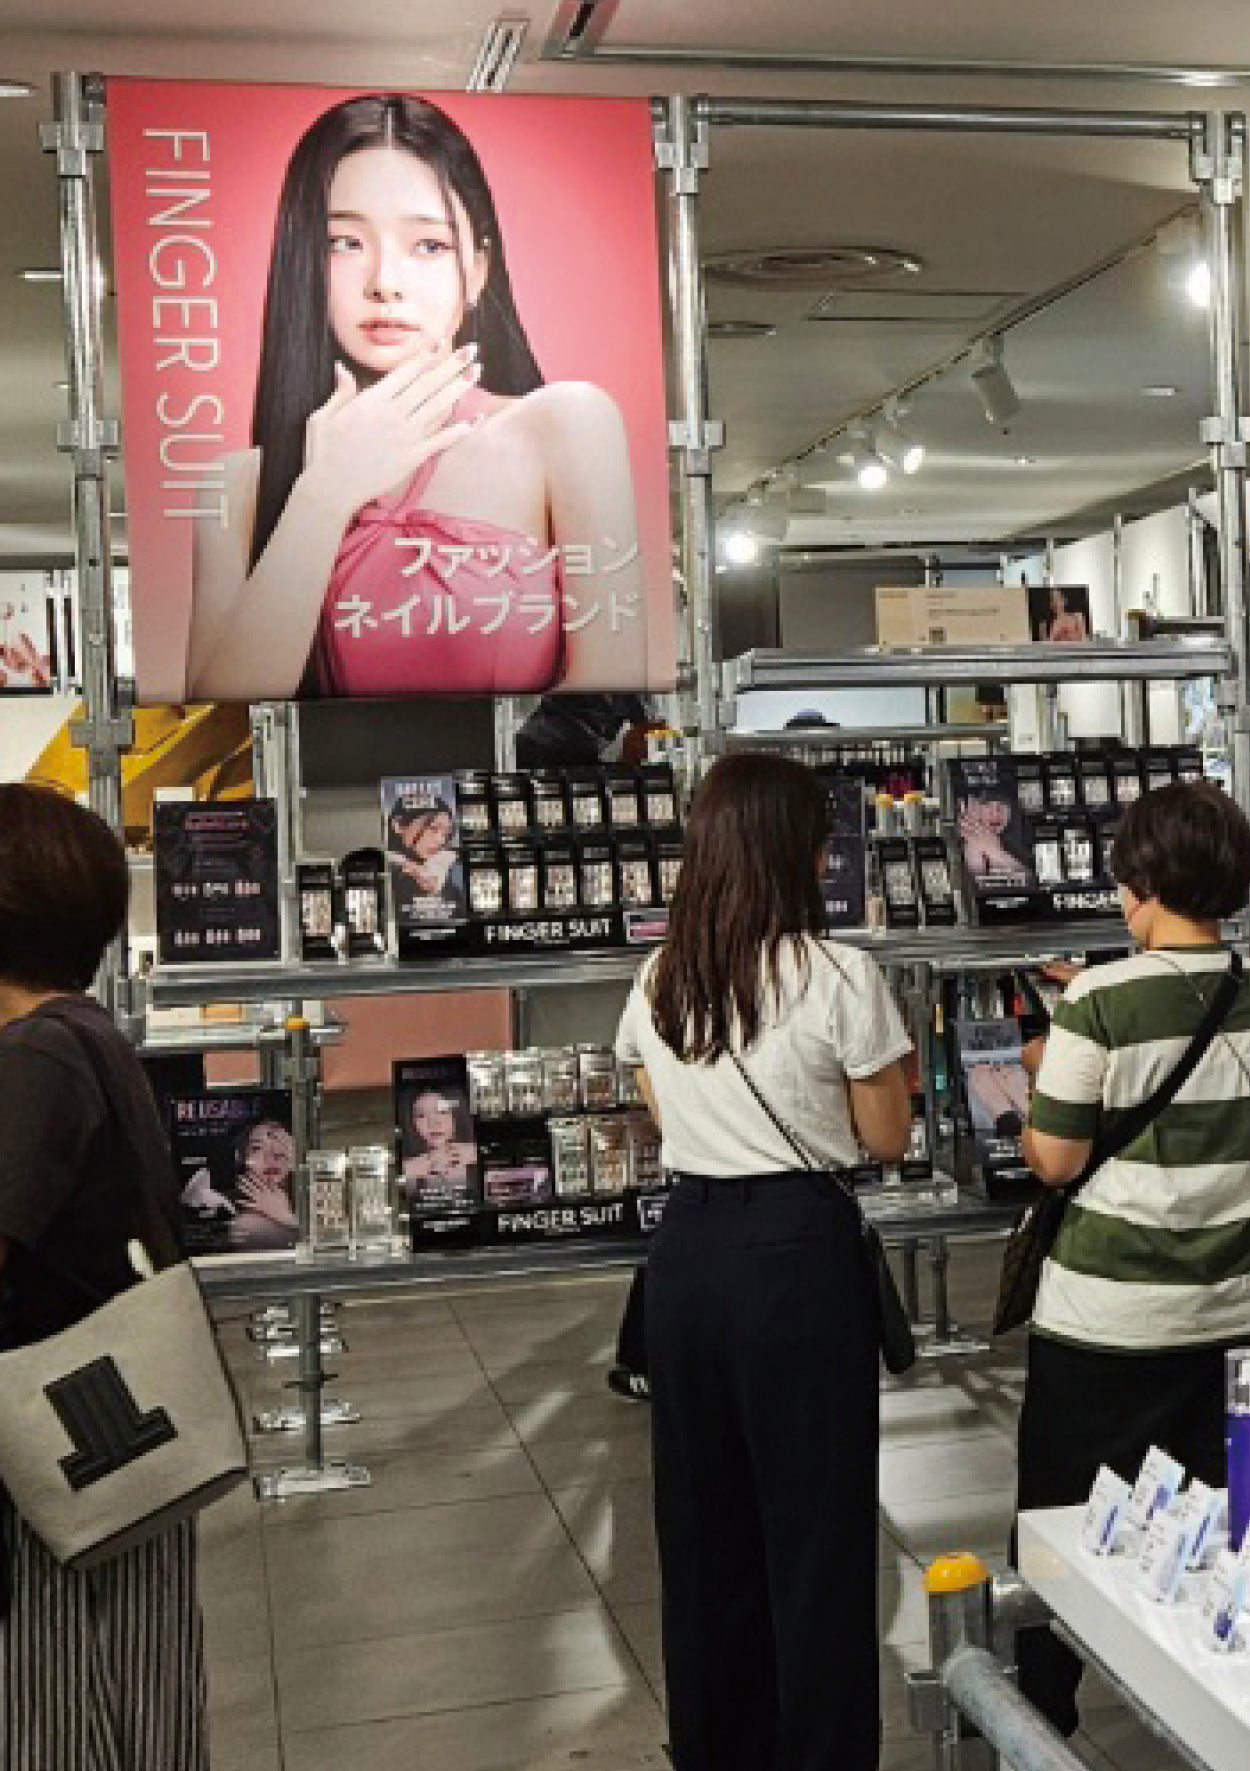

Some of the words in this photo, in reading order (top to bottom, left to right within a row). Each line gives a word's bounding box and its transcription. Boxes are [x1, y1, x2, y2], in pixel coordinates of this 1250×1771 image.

[142, 128, 220, 372] FINGER
[156, 391, 229, 529] SUIT
[394, 537, 638, 578] ファッション
[333, 590, 638, 638] ネイルブランド
